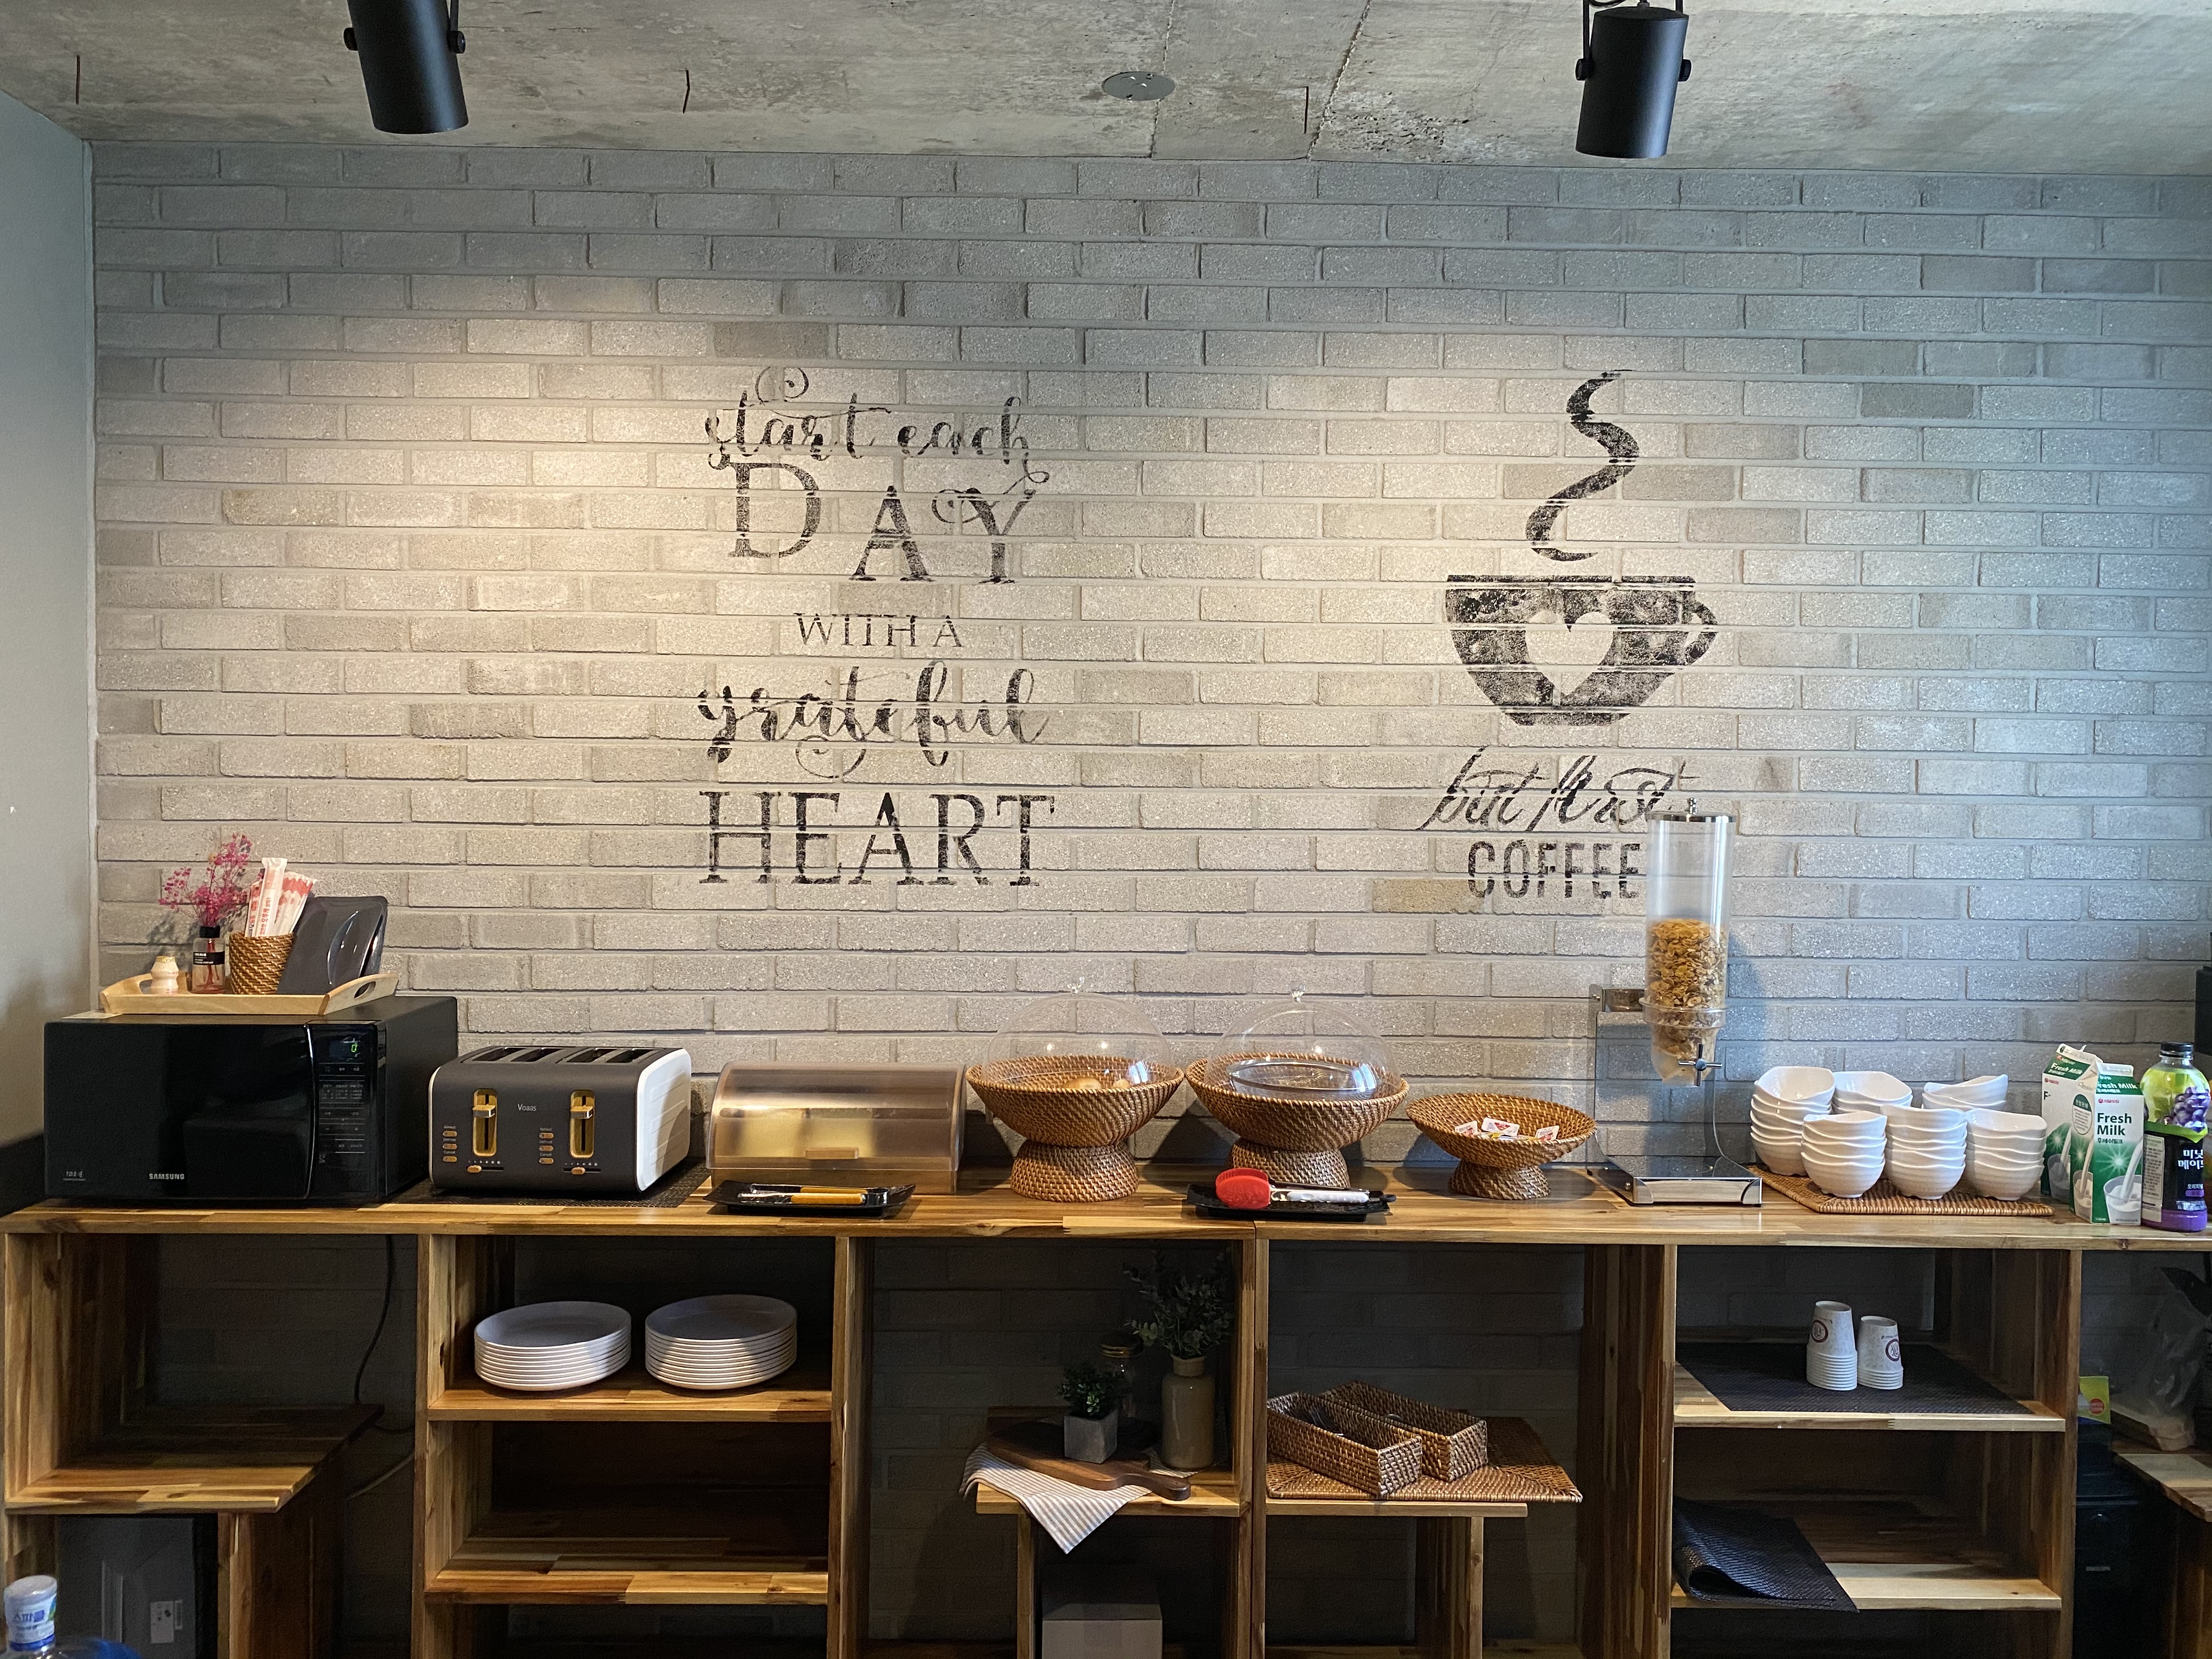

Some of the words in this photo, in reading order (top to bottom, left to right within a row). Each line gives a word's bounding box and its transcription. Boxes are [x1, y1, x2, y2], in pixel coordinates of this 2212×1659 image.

[898, 396, 1049, 488] each
[727, 462, 1037, 584] DAY
[793, 613, 918, 647] WITH
[934, 614, 963, 647] A
[697, 660, 1049, 778] grateful
[1415, 745, 1550, 830] but
[699, 791, 1055, 886] HEART
[1468, 839, 1640, 899] COFFEE
[2051, 1063, 2069, 1071] Fresh
[2097, 1113, 2132, 1124] Fresh
[2097, 1125, 2126, 1136] Milk
